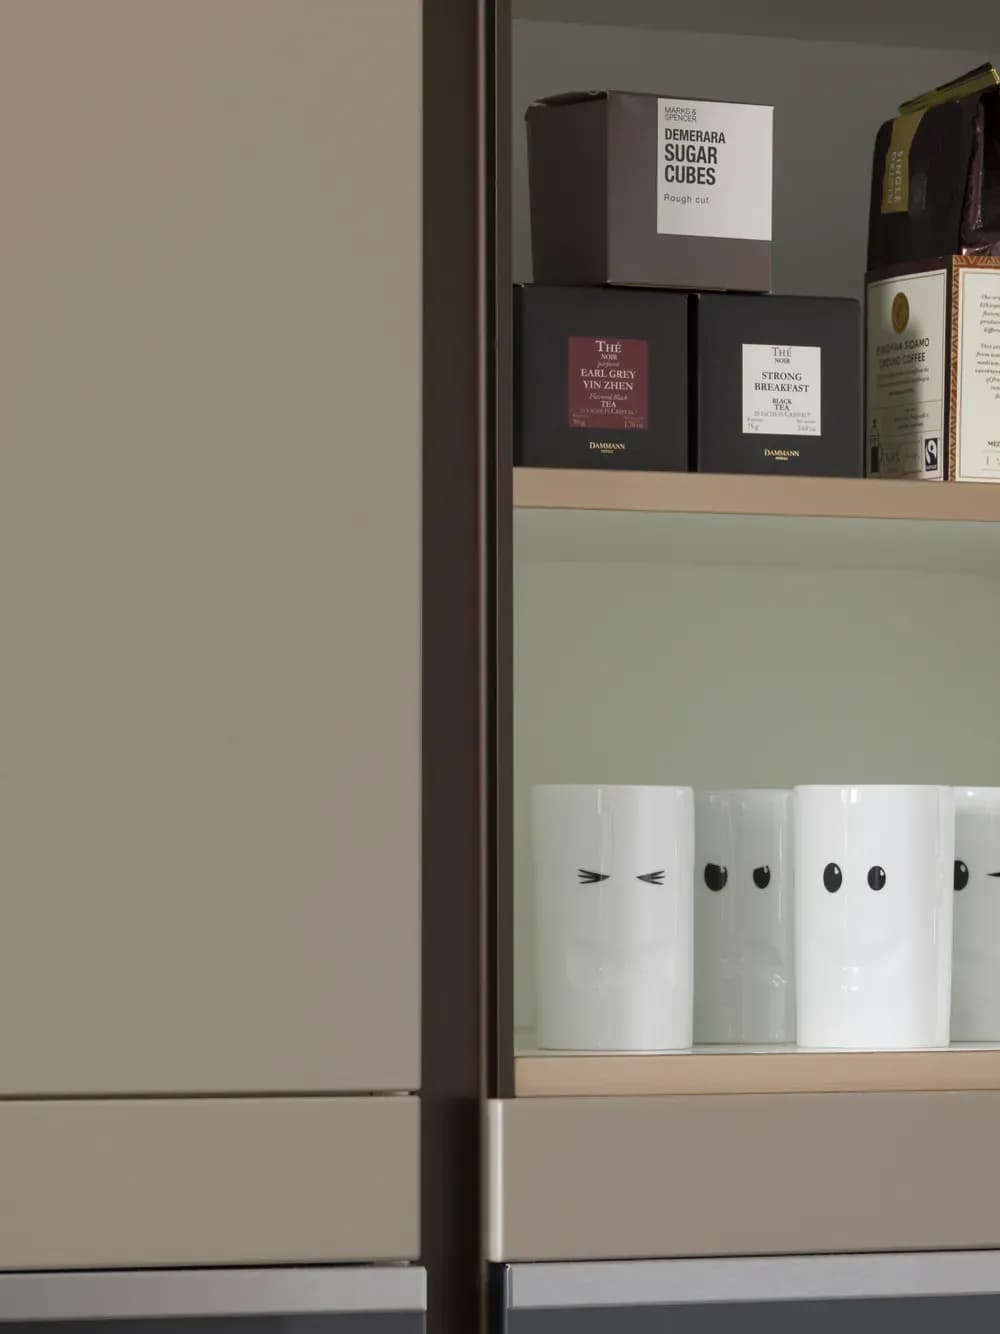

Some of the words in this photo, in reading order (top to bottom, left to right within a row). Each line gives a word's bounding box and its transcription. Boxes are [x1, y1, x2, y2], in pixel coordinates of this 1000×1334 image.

[664, 128, 726, 144] DEMERARA
[664, 143, 718, 164] SUGAR
[664, 164, 717, 186] CUBES
[663, 193, 692, 205] Rough
[695, 196, 709, 204] cut
[580, 368, 607, 378] EARL
[608, 369, 636, 379] GREY
[761, 371, 802, 382] STRONG
[583, 380, 601, 389] YIN
[603, 381, 633, 390] ZHEN
[754, 382, 810, 393] BREAKFAST
[600, 400, 617, 408] TEA
[774, 404, 790, 412] TEA
[589, 441, 625, 450] DAMMANN
[764, 448, 800, 458] DAMMANN
